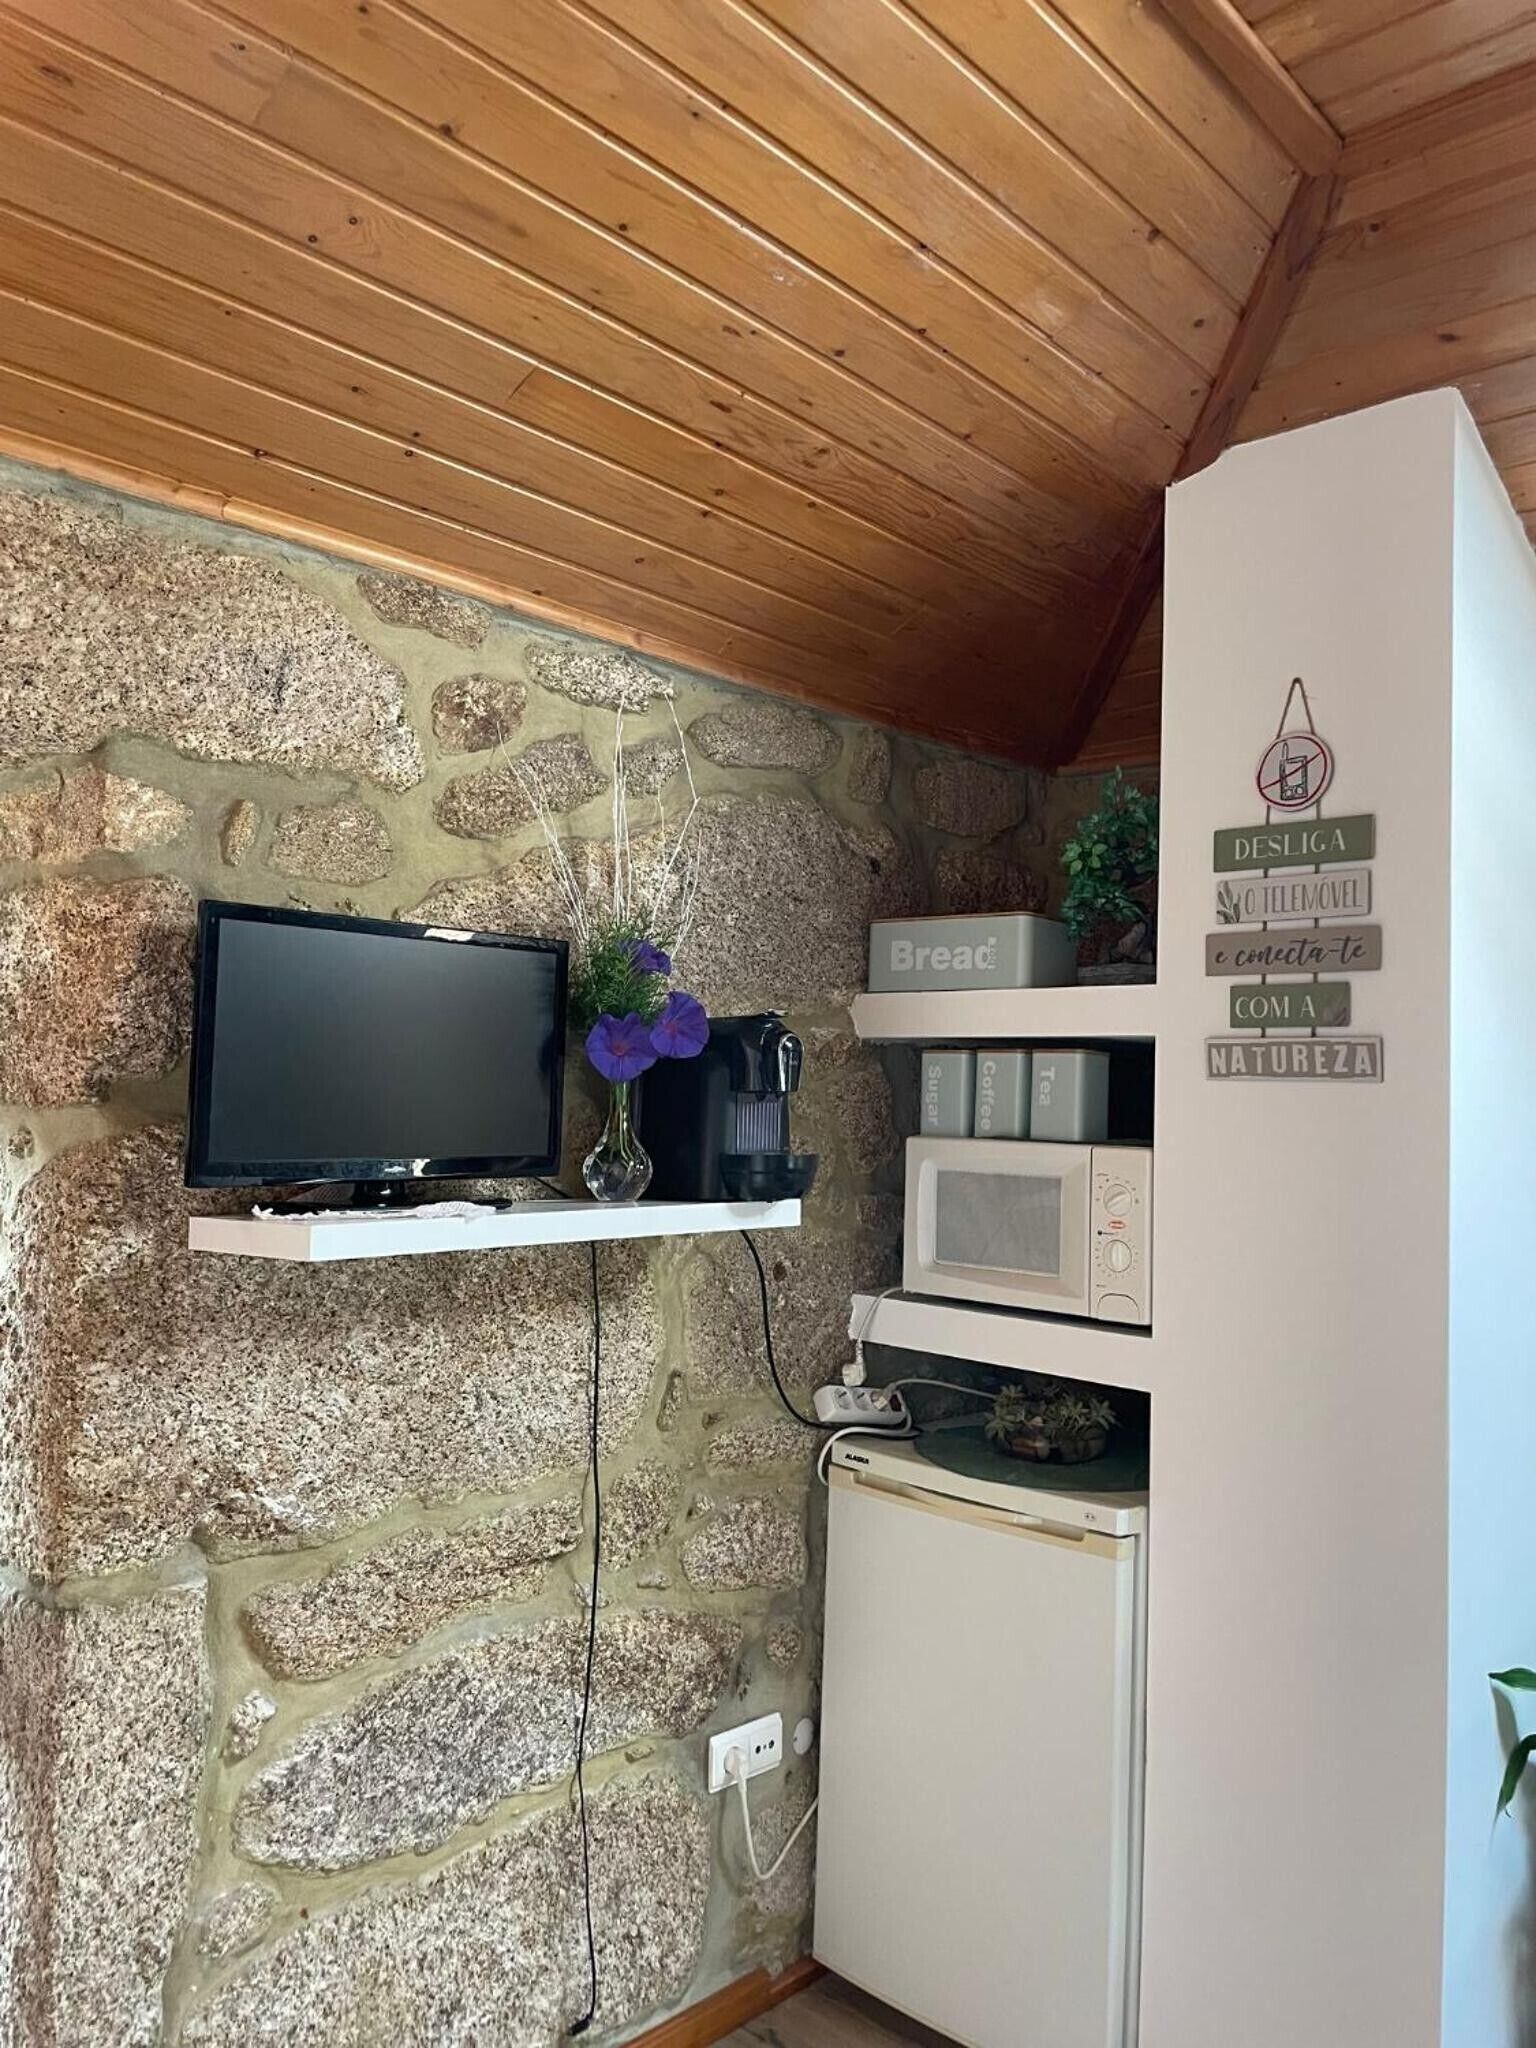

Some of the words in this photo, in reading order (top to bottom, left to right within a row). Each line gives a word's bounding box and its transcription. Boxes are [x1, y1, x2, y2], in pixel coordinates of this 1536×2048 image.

[1234, 828, 1346, 861] DESLIGA
[1244, 887, 1256, 915] O
[1263, 876, 1363, 914] TELEMÓVEL
[890, 937, 997, 971] Bread
[1215, 949, 1228, 964] e
[1235, 936, 1366, 967] conecta-te
[1234, 995, 1289, 1019] COM
[1299, 995, 1316, 1018] A
[1210, 1044, 1374, 1075] NATUREZA
[926, 1065, 942, 1126] Sugar
[980, 1061, 996, 1130] Coffee
[1039, 1066, 1056, 1105] Tea
